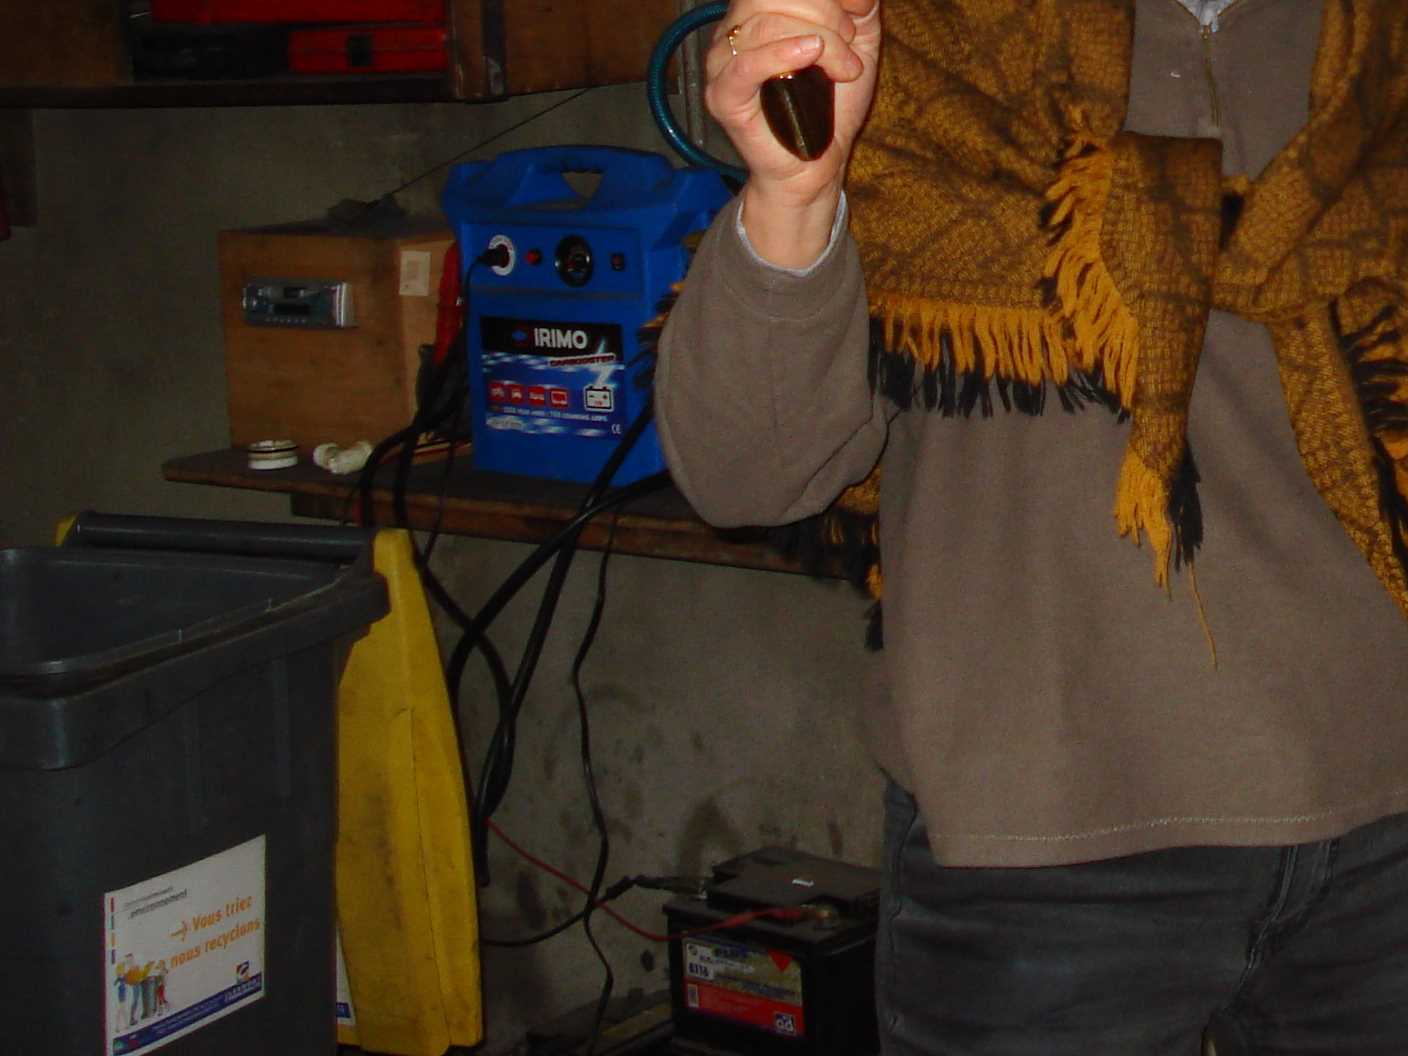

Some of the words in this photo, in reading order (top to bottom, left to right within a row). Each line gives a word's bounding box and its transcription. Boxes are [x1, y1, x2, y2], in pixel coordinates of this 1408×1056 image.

[533, 328, 588, 350] IRIMO
[191, 909, 223, 932] Vous
[170, 945, 201, 969] nous
[204, 918, 262, 953] recyclons
